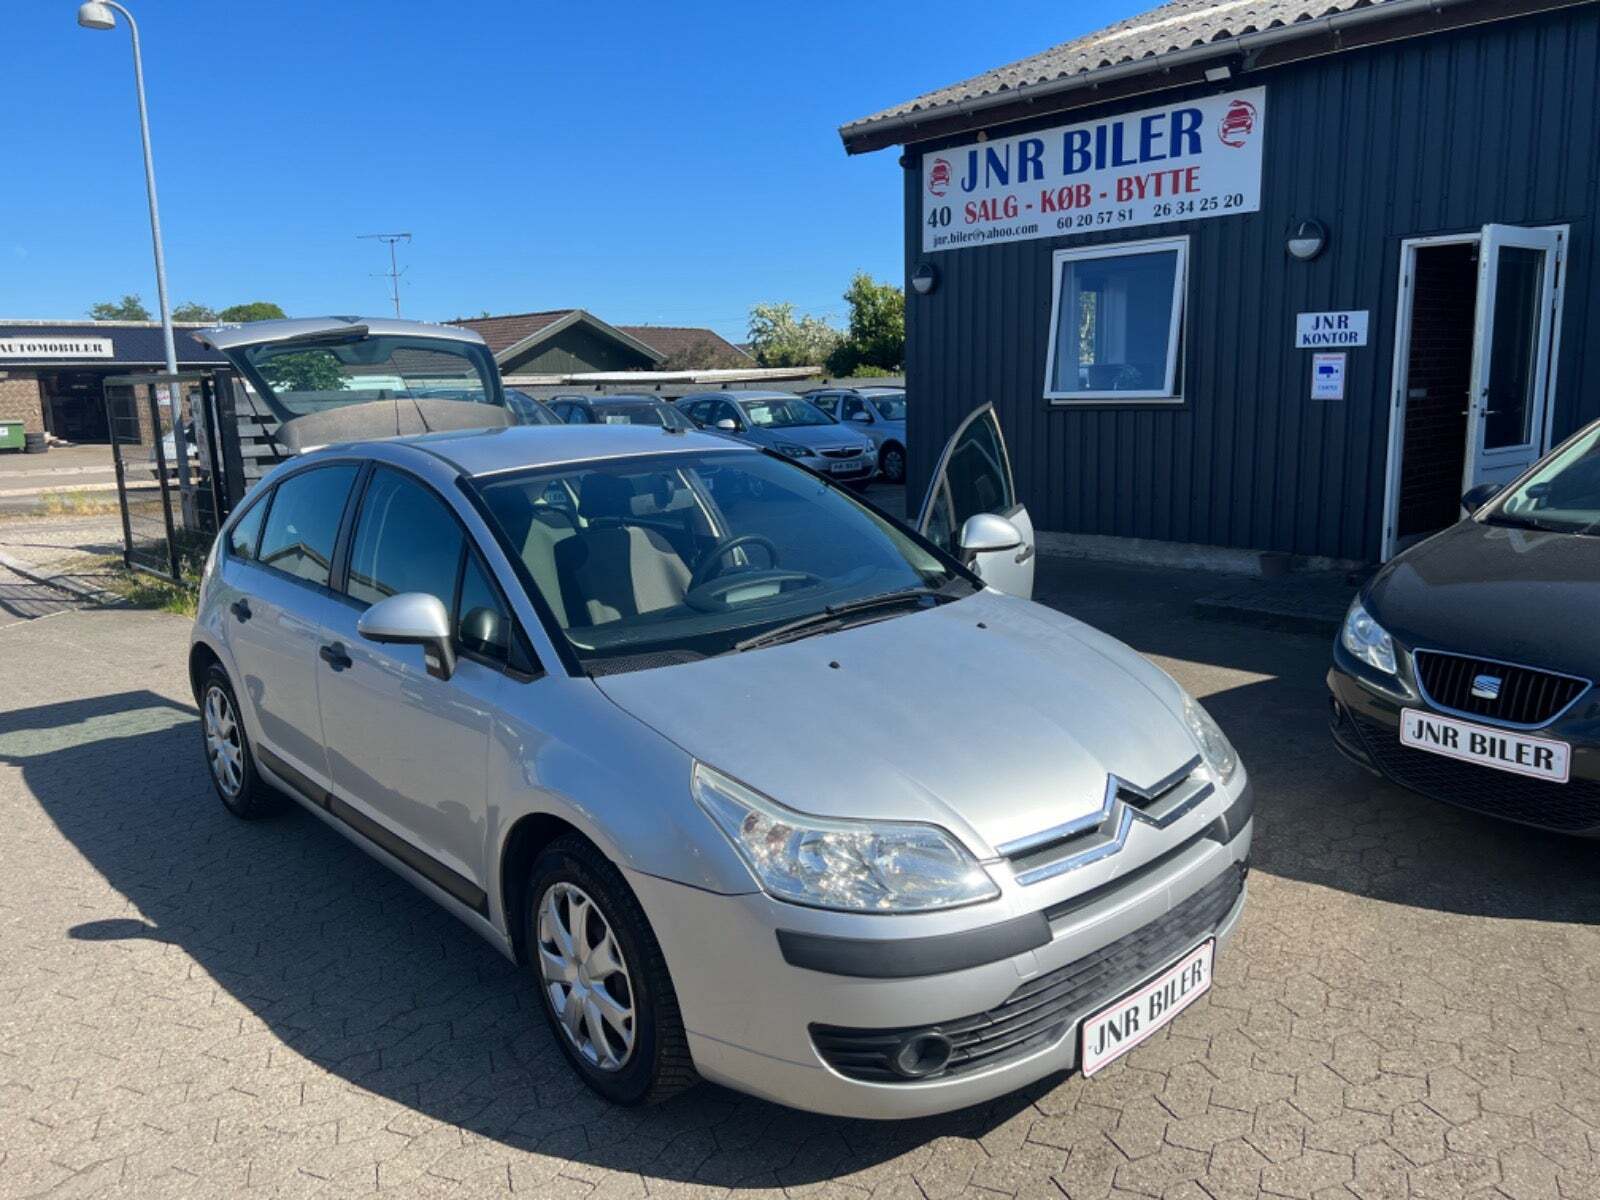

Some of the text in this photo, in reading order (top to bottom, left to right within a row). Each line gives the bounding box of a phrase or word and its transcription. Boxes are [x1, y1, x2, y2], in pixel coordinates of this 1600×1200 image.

[961, 108, 1203, 192] JNR BILER
[965, 195, 1018, 224] SALG
[1041, 183, 1091, 213] KØB
[1117, 166, 1200, 202] BYTTE
[1153, 193, 1243, 218] 26 34 25 20
[927, 206, 951, 228] 40
[1057, 208, 1133, 229] 60 20 57 81
[933, 223, 1039, 247] jnr.biler@yahoo.com
[1312, 314, 1349, 330] JNR
[1302, 331, 1358, 345] KONTOR
[1412, 719, 1553, 770] JNR BILER
[1094, 958, 1202, 1055] JNR BILER
